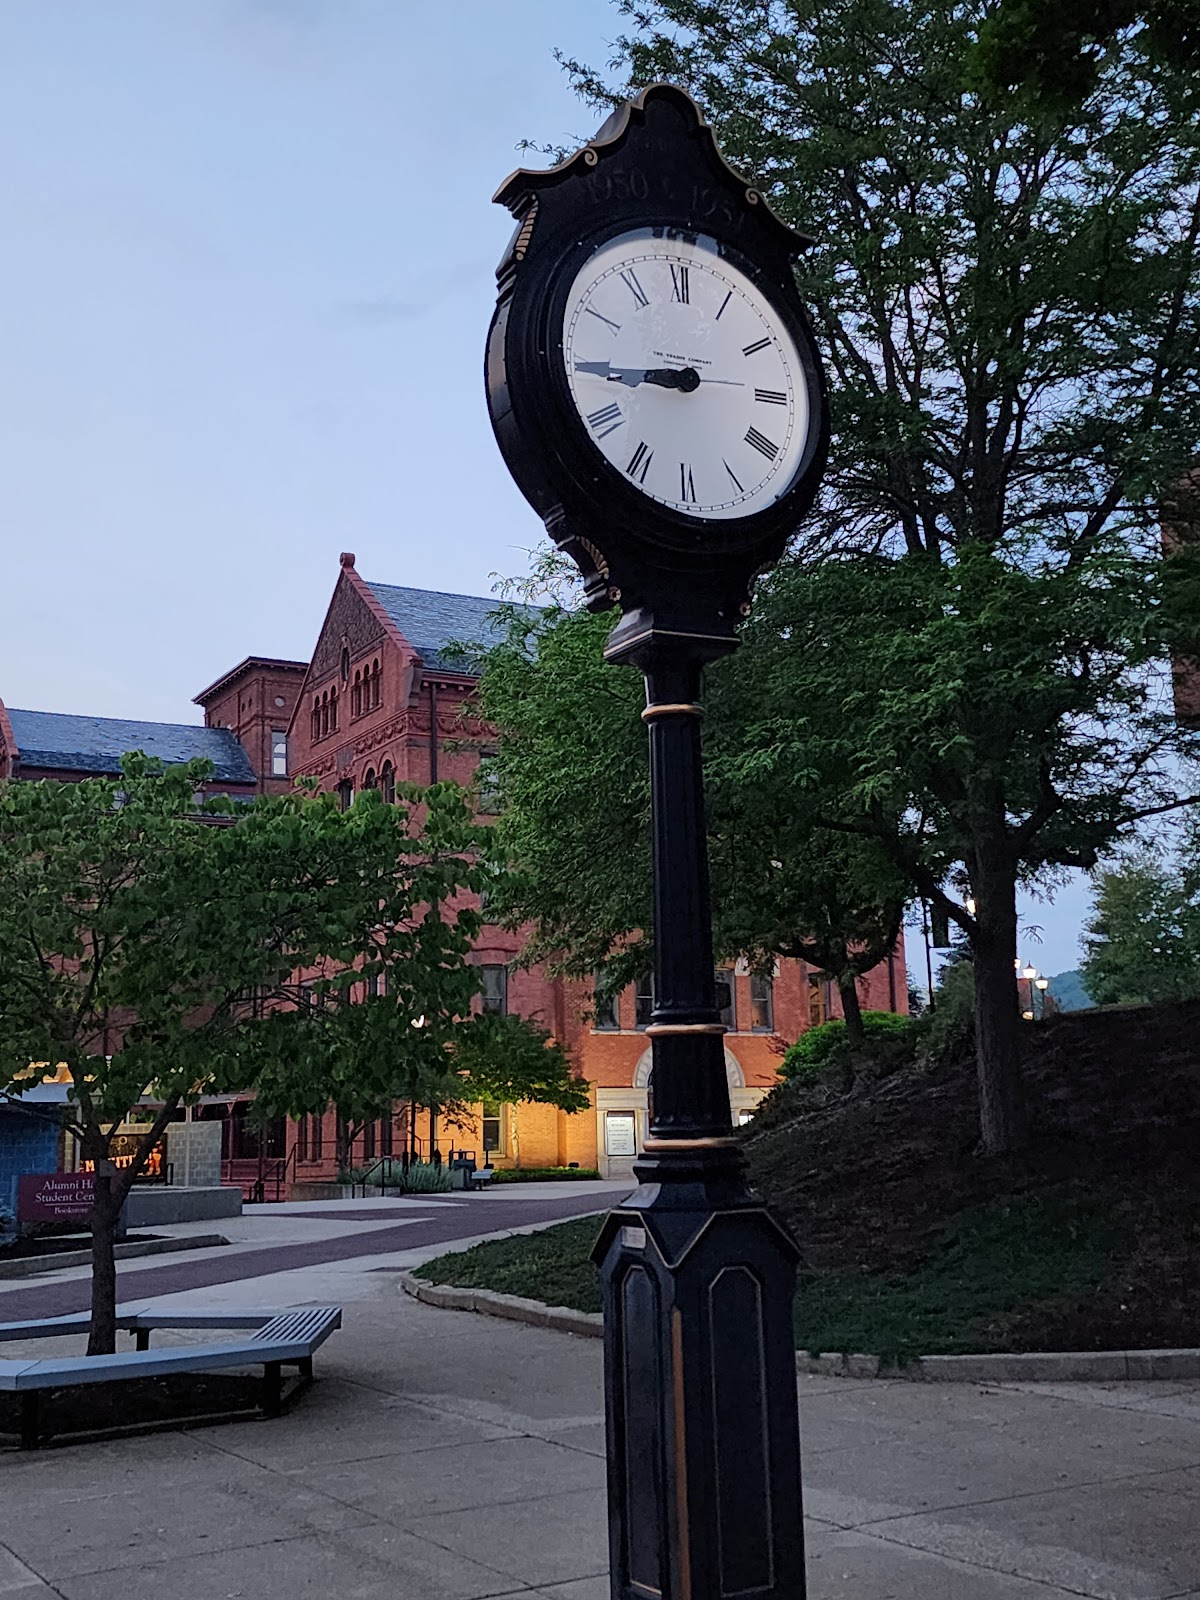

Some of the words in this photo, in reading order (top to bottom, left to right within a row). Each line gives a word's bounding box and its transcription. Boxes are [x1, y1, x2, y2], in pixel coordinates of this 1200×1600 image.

[688, 357, 712, 365] COMPANY
[43, 1179, 79, 1190] Alumni
[35, 1191, 73, 1203] Student
